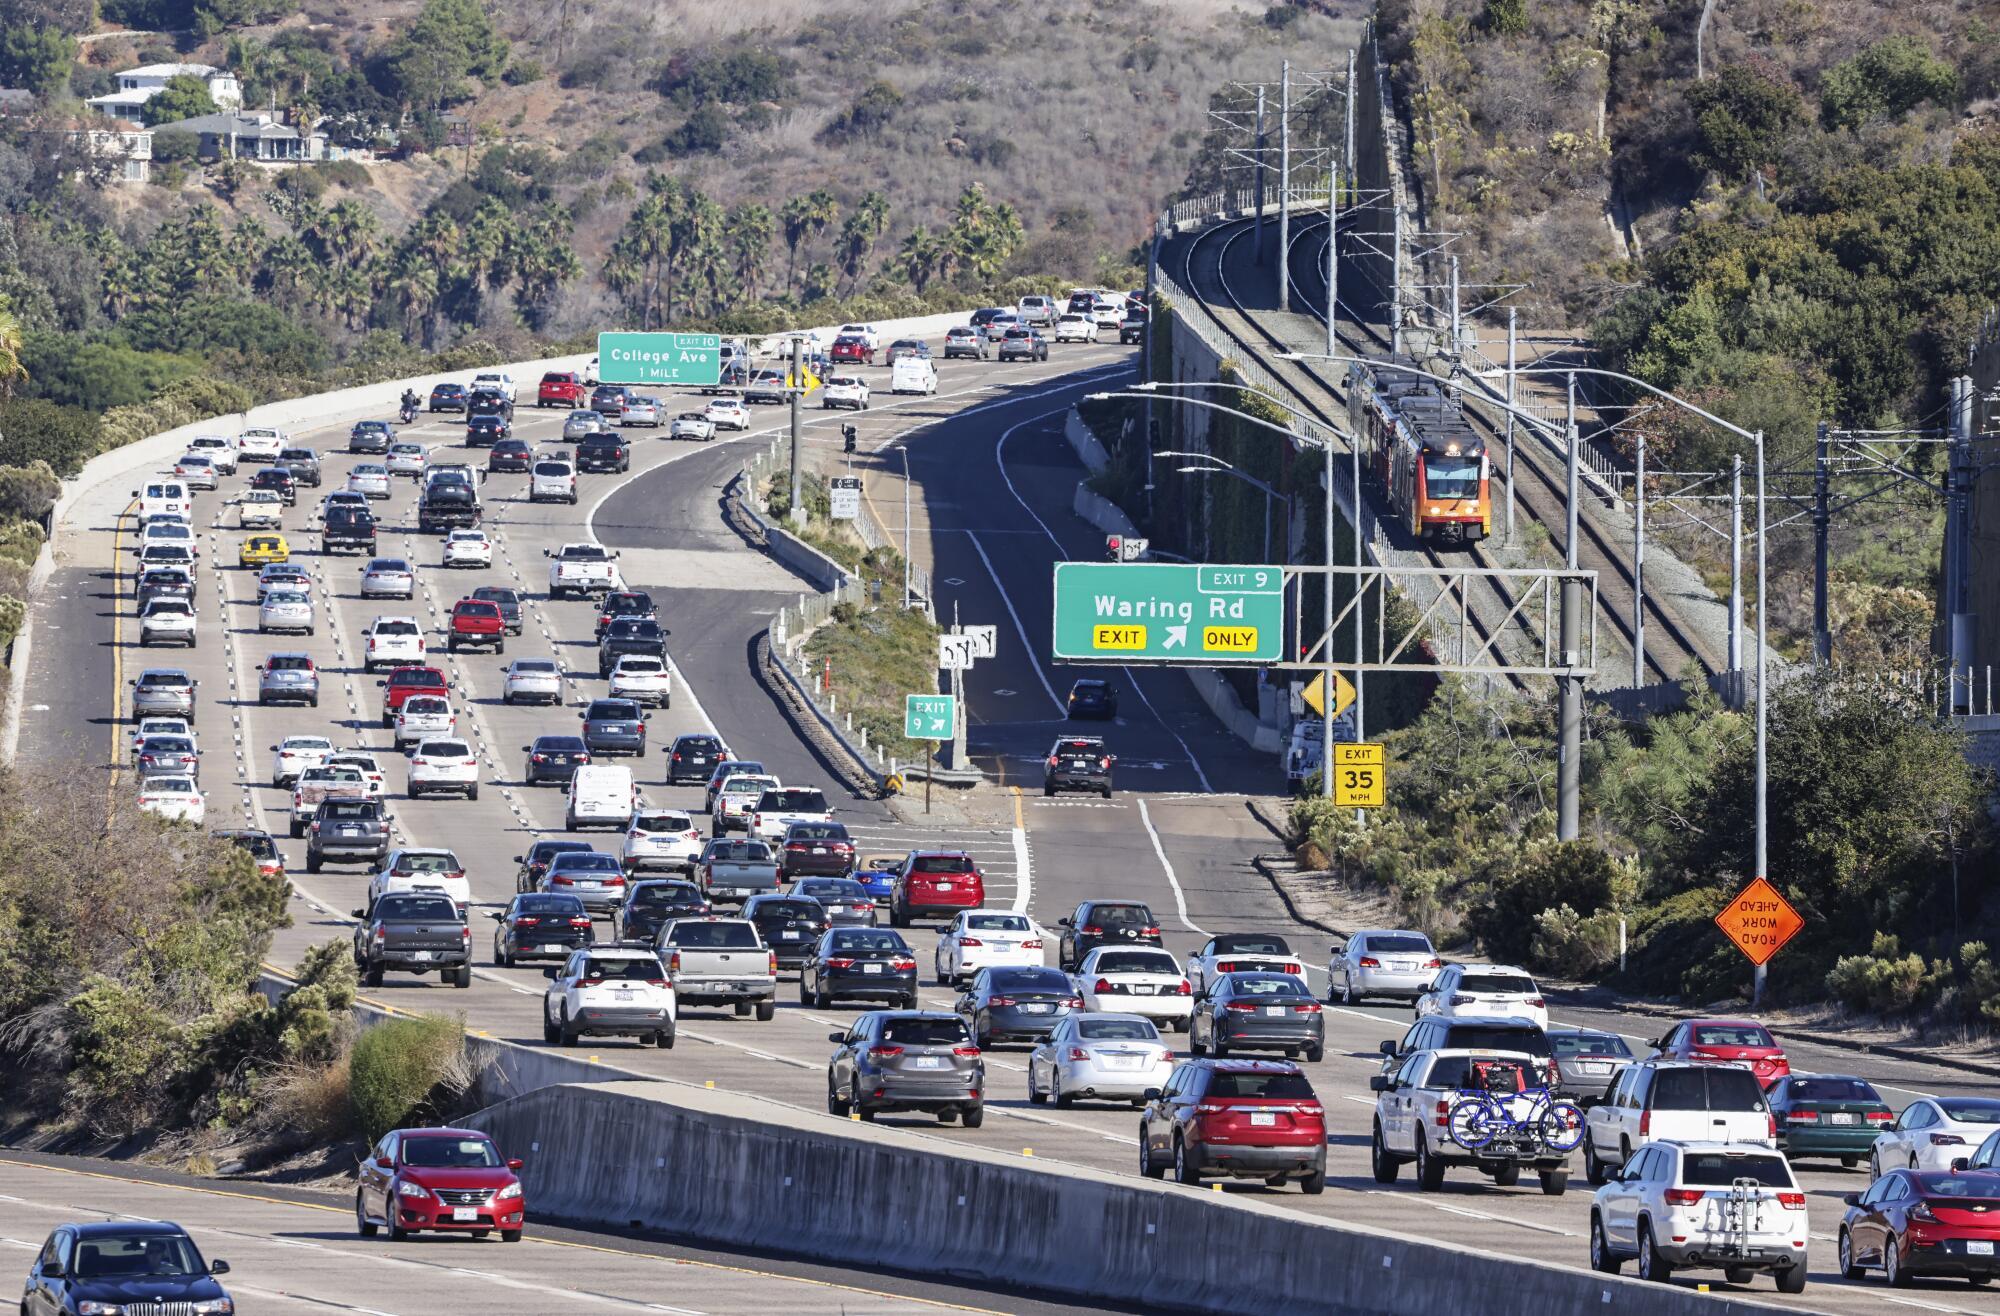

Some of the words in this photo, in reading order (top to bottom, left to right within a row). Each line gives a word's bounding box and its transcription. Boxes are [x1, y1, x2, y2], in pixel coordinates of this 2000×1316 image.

[702, 337, 715, 347] 10
[611, 348, 670, 364] College
[679, 350, 708, 363] Ave
[639, 367, 644, 377] 1
[650, 367, 679, 378] MILE
[1213, 573, 1246, 585] EXIT
[1254, 572, 1268, 588] 9
[1094, 595, 1193, 624] Waring
[1209, 597, 1244, 619] Rd
[1099, 630, 1140, 644] EXIT
[1207, 632, 1254, 646] ONLY
[915, 702, 947, 713] EXIT
[913, 717, 922, 731] 9
[1345, 749, 1372, 759] EXIT
[1345, 770, 1373, 789] 35
[1350, 793, 1370, 801] MPH
[1740, 901, 1779, 912] AHEAD
[1742, 917, 1777, 928] WORK
[1742, 933, 1777, 945] ROAD
